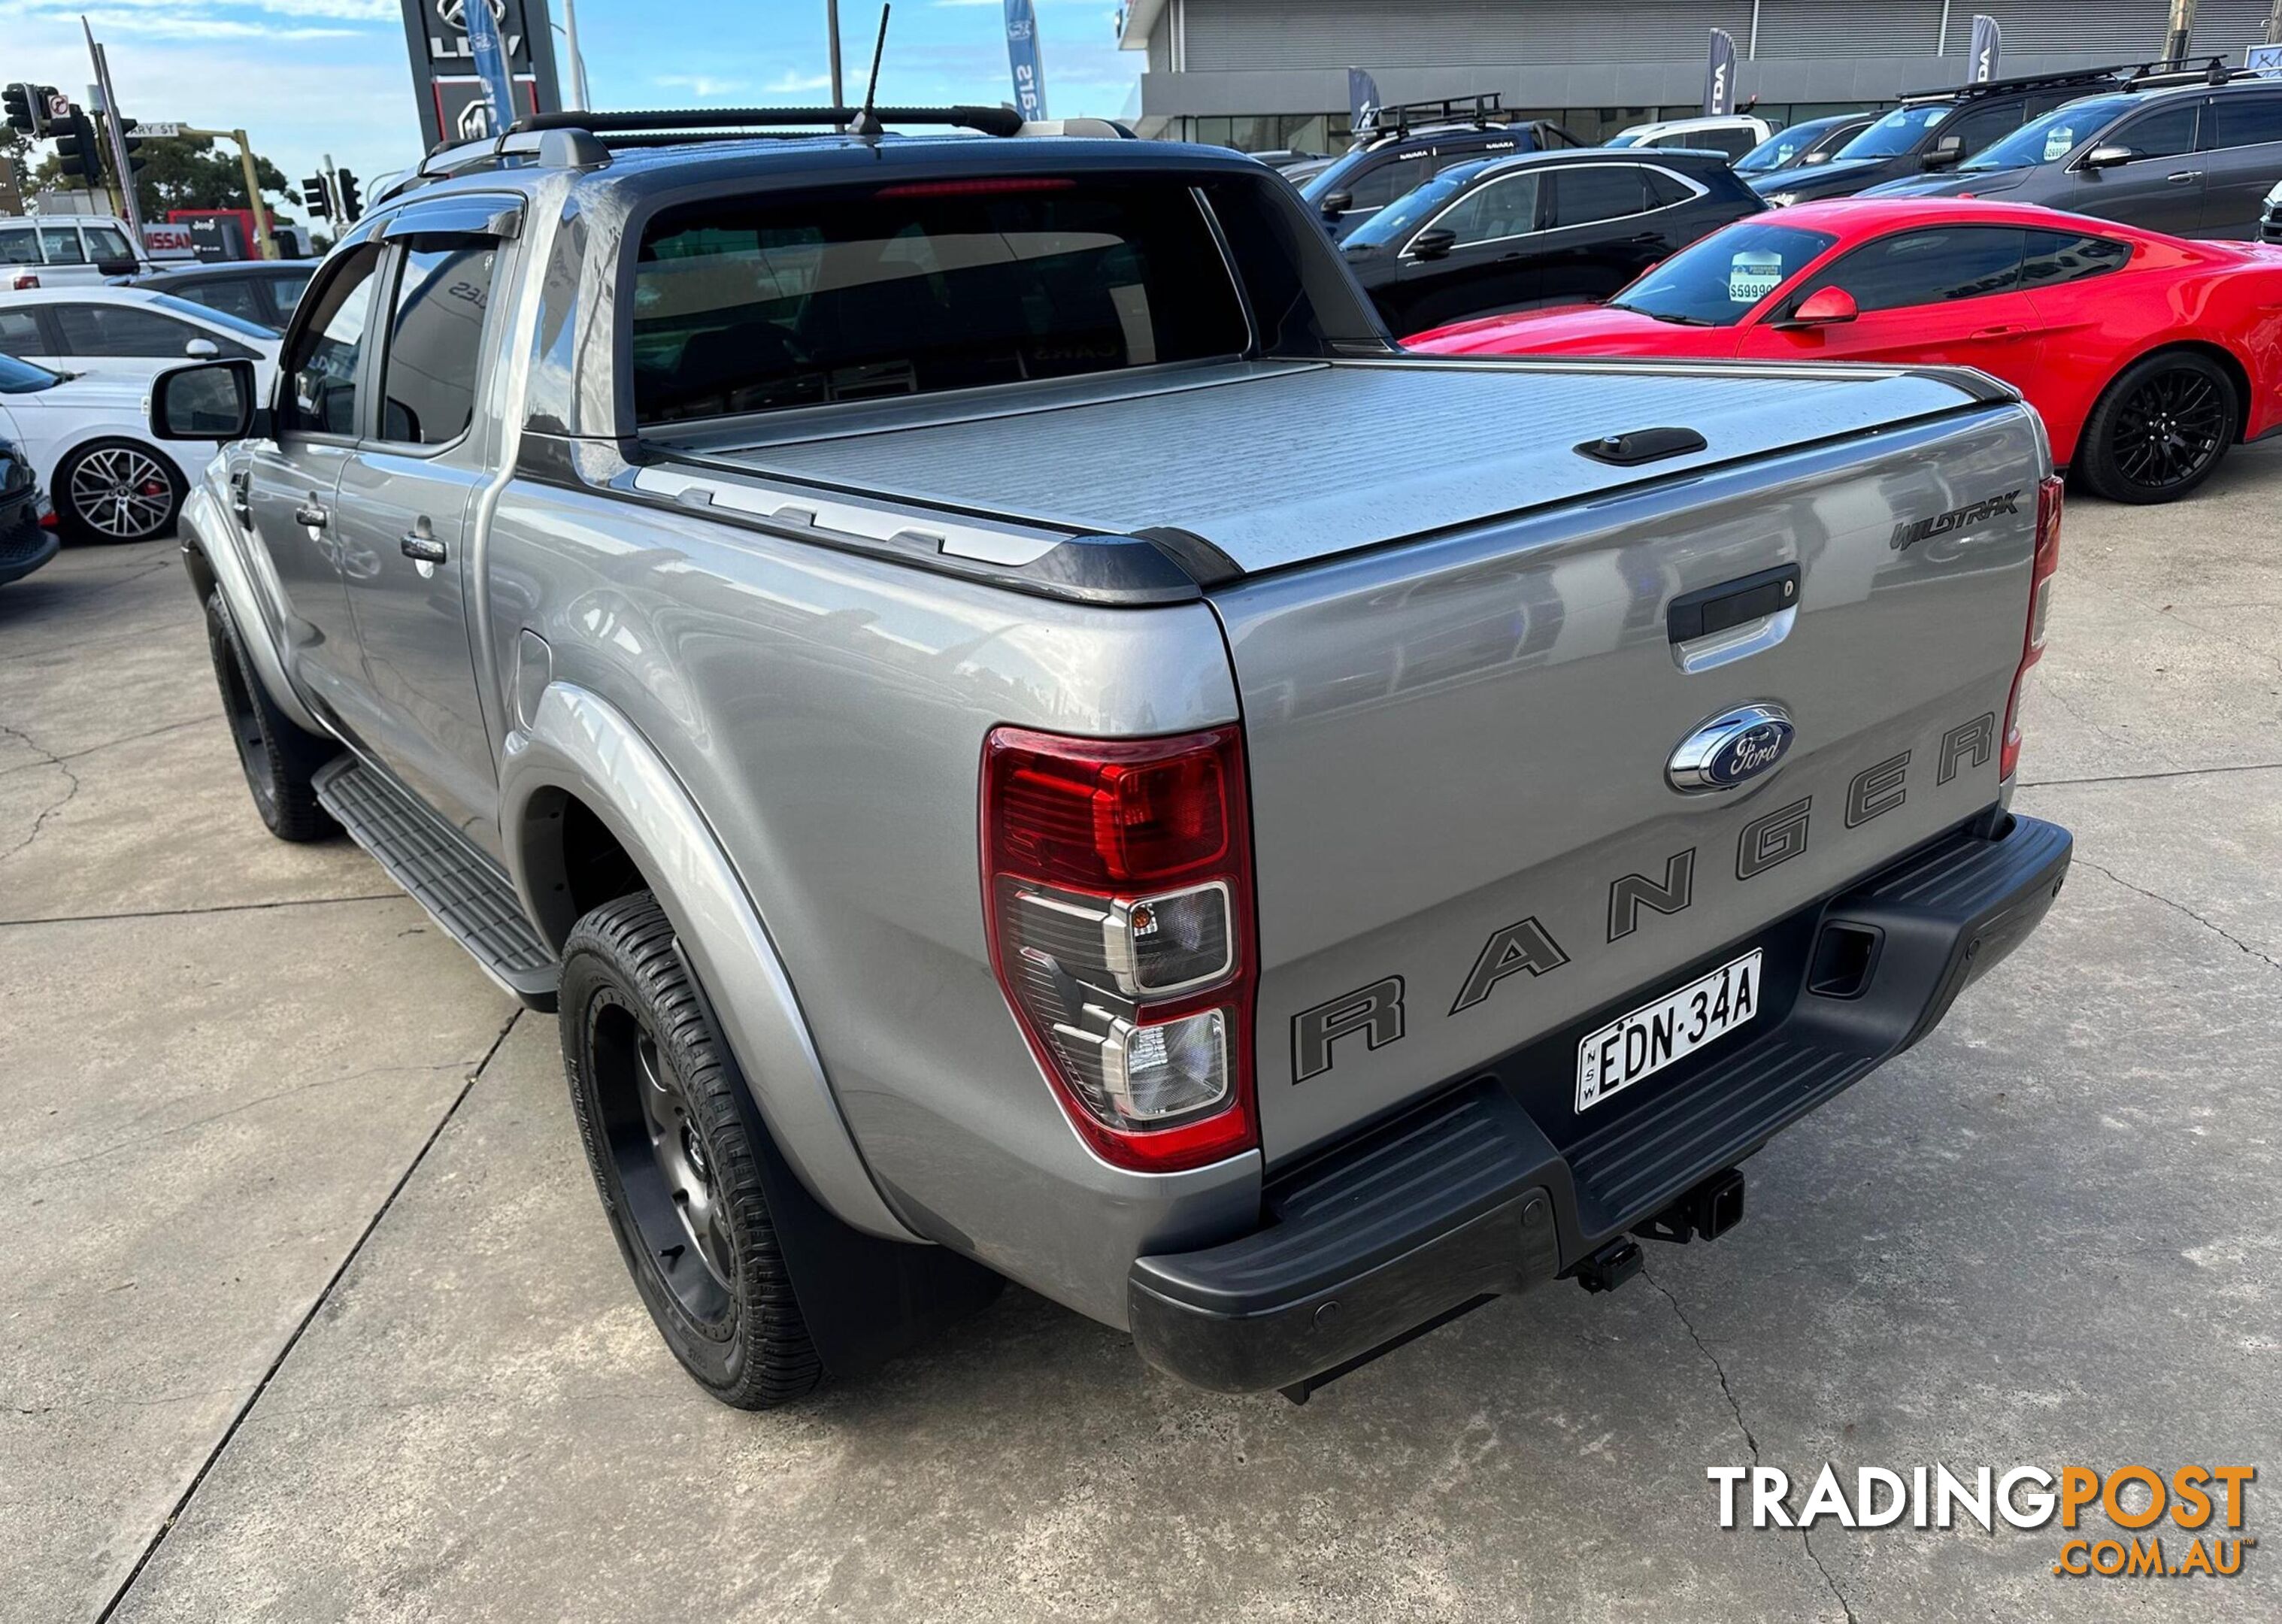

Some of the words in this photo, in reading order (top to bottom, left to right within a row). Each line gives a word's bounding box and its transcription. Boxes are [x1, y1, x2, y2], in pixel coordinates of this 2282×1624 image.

[160, 124, 174, 135] ST
[1400, 150, 1428, 160] NAVARA
[1486, 141, 1514, 150] NAVARA
[1890, 489, 2021, 551] WILDTRAK
[1730, 731, 1782, 775] Ford
[1291, 711, 1996, 1086] RANGER
